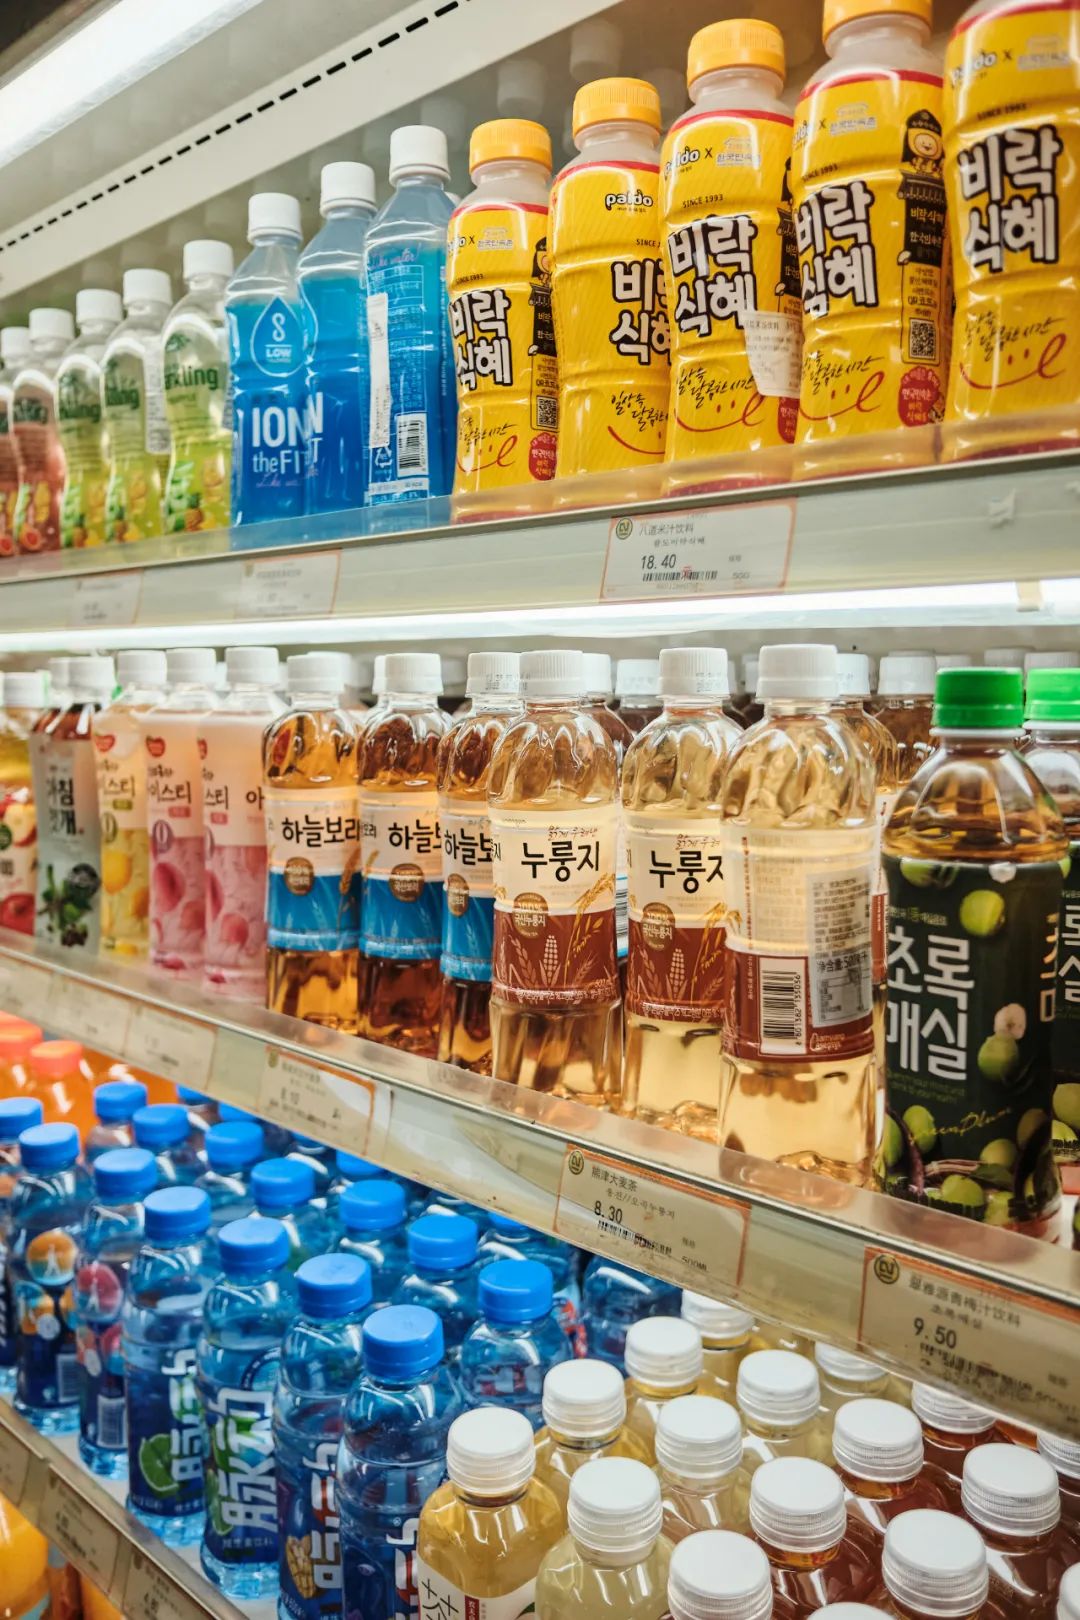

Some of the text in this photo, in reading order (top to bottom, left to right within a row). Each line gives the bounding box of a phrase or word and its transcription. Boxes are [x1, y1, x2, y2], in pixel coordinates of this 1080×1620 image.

[958, 124, 1063, 202] 비락
[605, 189, 653, 211] paldo
[682, 194, 724, 208] SINCE 1993
[794, 180, 874, 254] 비락
[636, 238, 656, 247] SINCE
[668, 213, 758, 276] 비락
[965, 194, 1060, 273] 식혜
[610, 258, 667, 313] 비
[801, 243, 879, 318] 식혜
[448, 288, 511, 341] 비락
[675, 271, 758, 338] 식혜
[266, 348, 292, 358] LOW
[457, 336, 513, 390] 식혜
[252, 406, 308, 448] ION
[641, 554, 677, 570] 18.40
[205, 785, 229, 810] 스티
[281, 814, 360, 848] 하늘보리
[388, 818, 441, 854] 하늘
[444, 828, 493, 866] 하늘보
[521, 840, 600, 883] 누룽지
[887, 924, 975, 1011] 초록
[887, 1000, 968, 1081] 매실
[594, 1200, 623, 1225] 8.30
[913, 1317, 957, 1350] 9.50
[208, 1388, 279, 1533] 脉动
